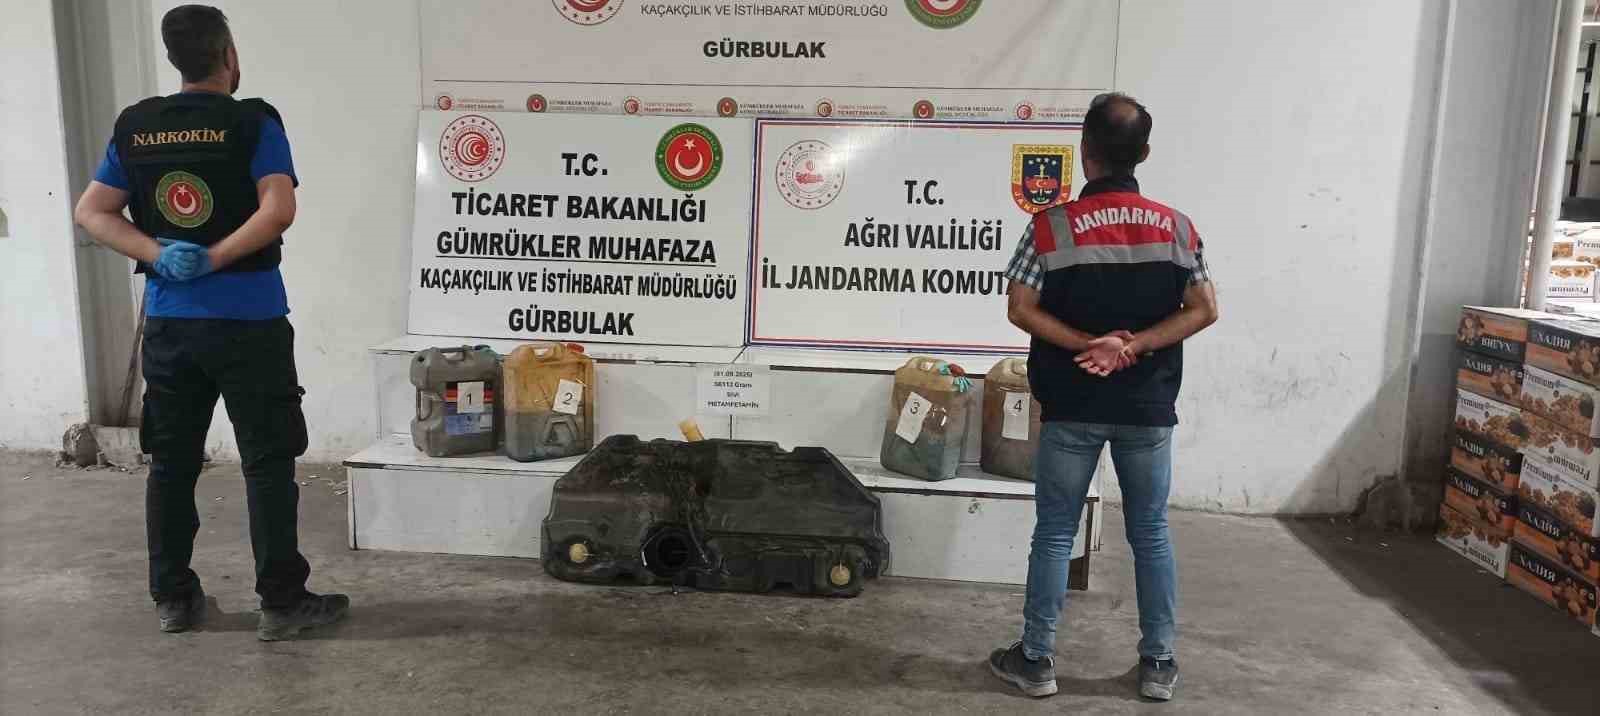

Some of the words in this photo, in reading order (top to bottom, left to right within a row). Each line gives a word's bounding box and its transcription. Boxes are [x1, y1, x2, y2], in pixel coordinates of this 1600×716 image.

[640, 4, 711, 18] KAÇAKÇILIK
[717, 5, 731, 16] VE
[734, 3, 805, 16] İSTİHBARAT
[808, 3, 888, 17] MÜDÜRLÜĞÜ
[703, 38, 826, 58] GÜRBULAK
[132, 128, 226, 146] NARKOKİM
[561, 152, 608, 176] T.C.
[904, 180, 944, 205] T.C.
[451, 188, 559, 218] TİCARET
[566, 194, 706, 223] BAKANLIĞI
[1073, 206, 1174, 234] JANDARMA
[436, 228, 581, 259] GÜMRÜKLER
[588, 235, 717, 264] MUHAFAZA
[844, 217, 899, 249] AĞRI
[905, 219, 1002, 251] VALİLİĞİ
[420, 268, 512, 295] KAÇAKÇILIK
[518, 271, 537, 293] VE
[541, 268, 633, 296] İSTİHBARAT
[637, 273, 737, 300] MÜDÜRLÜĞÜ
[762, 257, 781, 290] İL
[785, 265, 916, 294] JANDARMA
[922, 269, 1007, 296] KOMUT
[508, 305, 635, 336] GÜRBULAK
[466, 392, 472, 405] 1
[562, 391, 573, 406] 2
[910, 401, 920, 415] 3
[1013, 399, 1023, 413] 4
